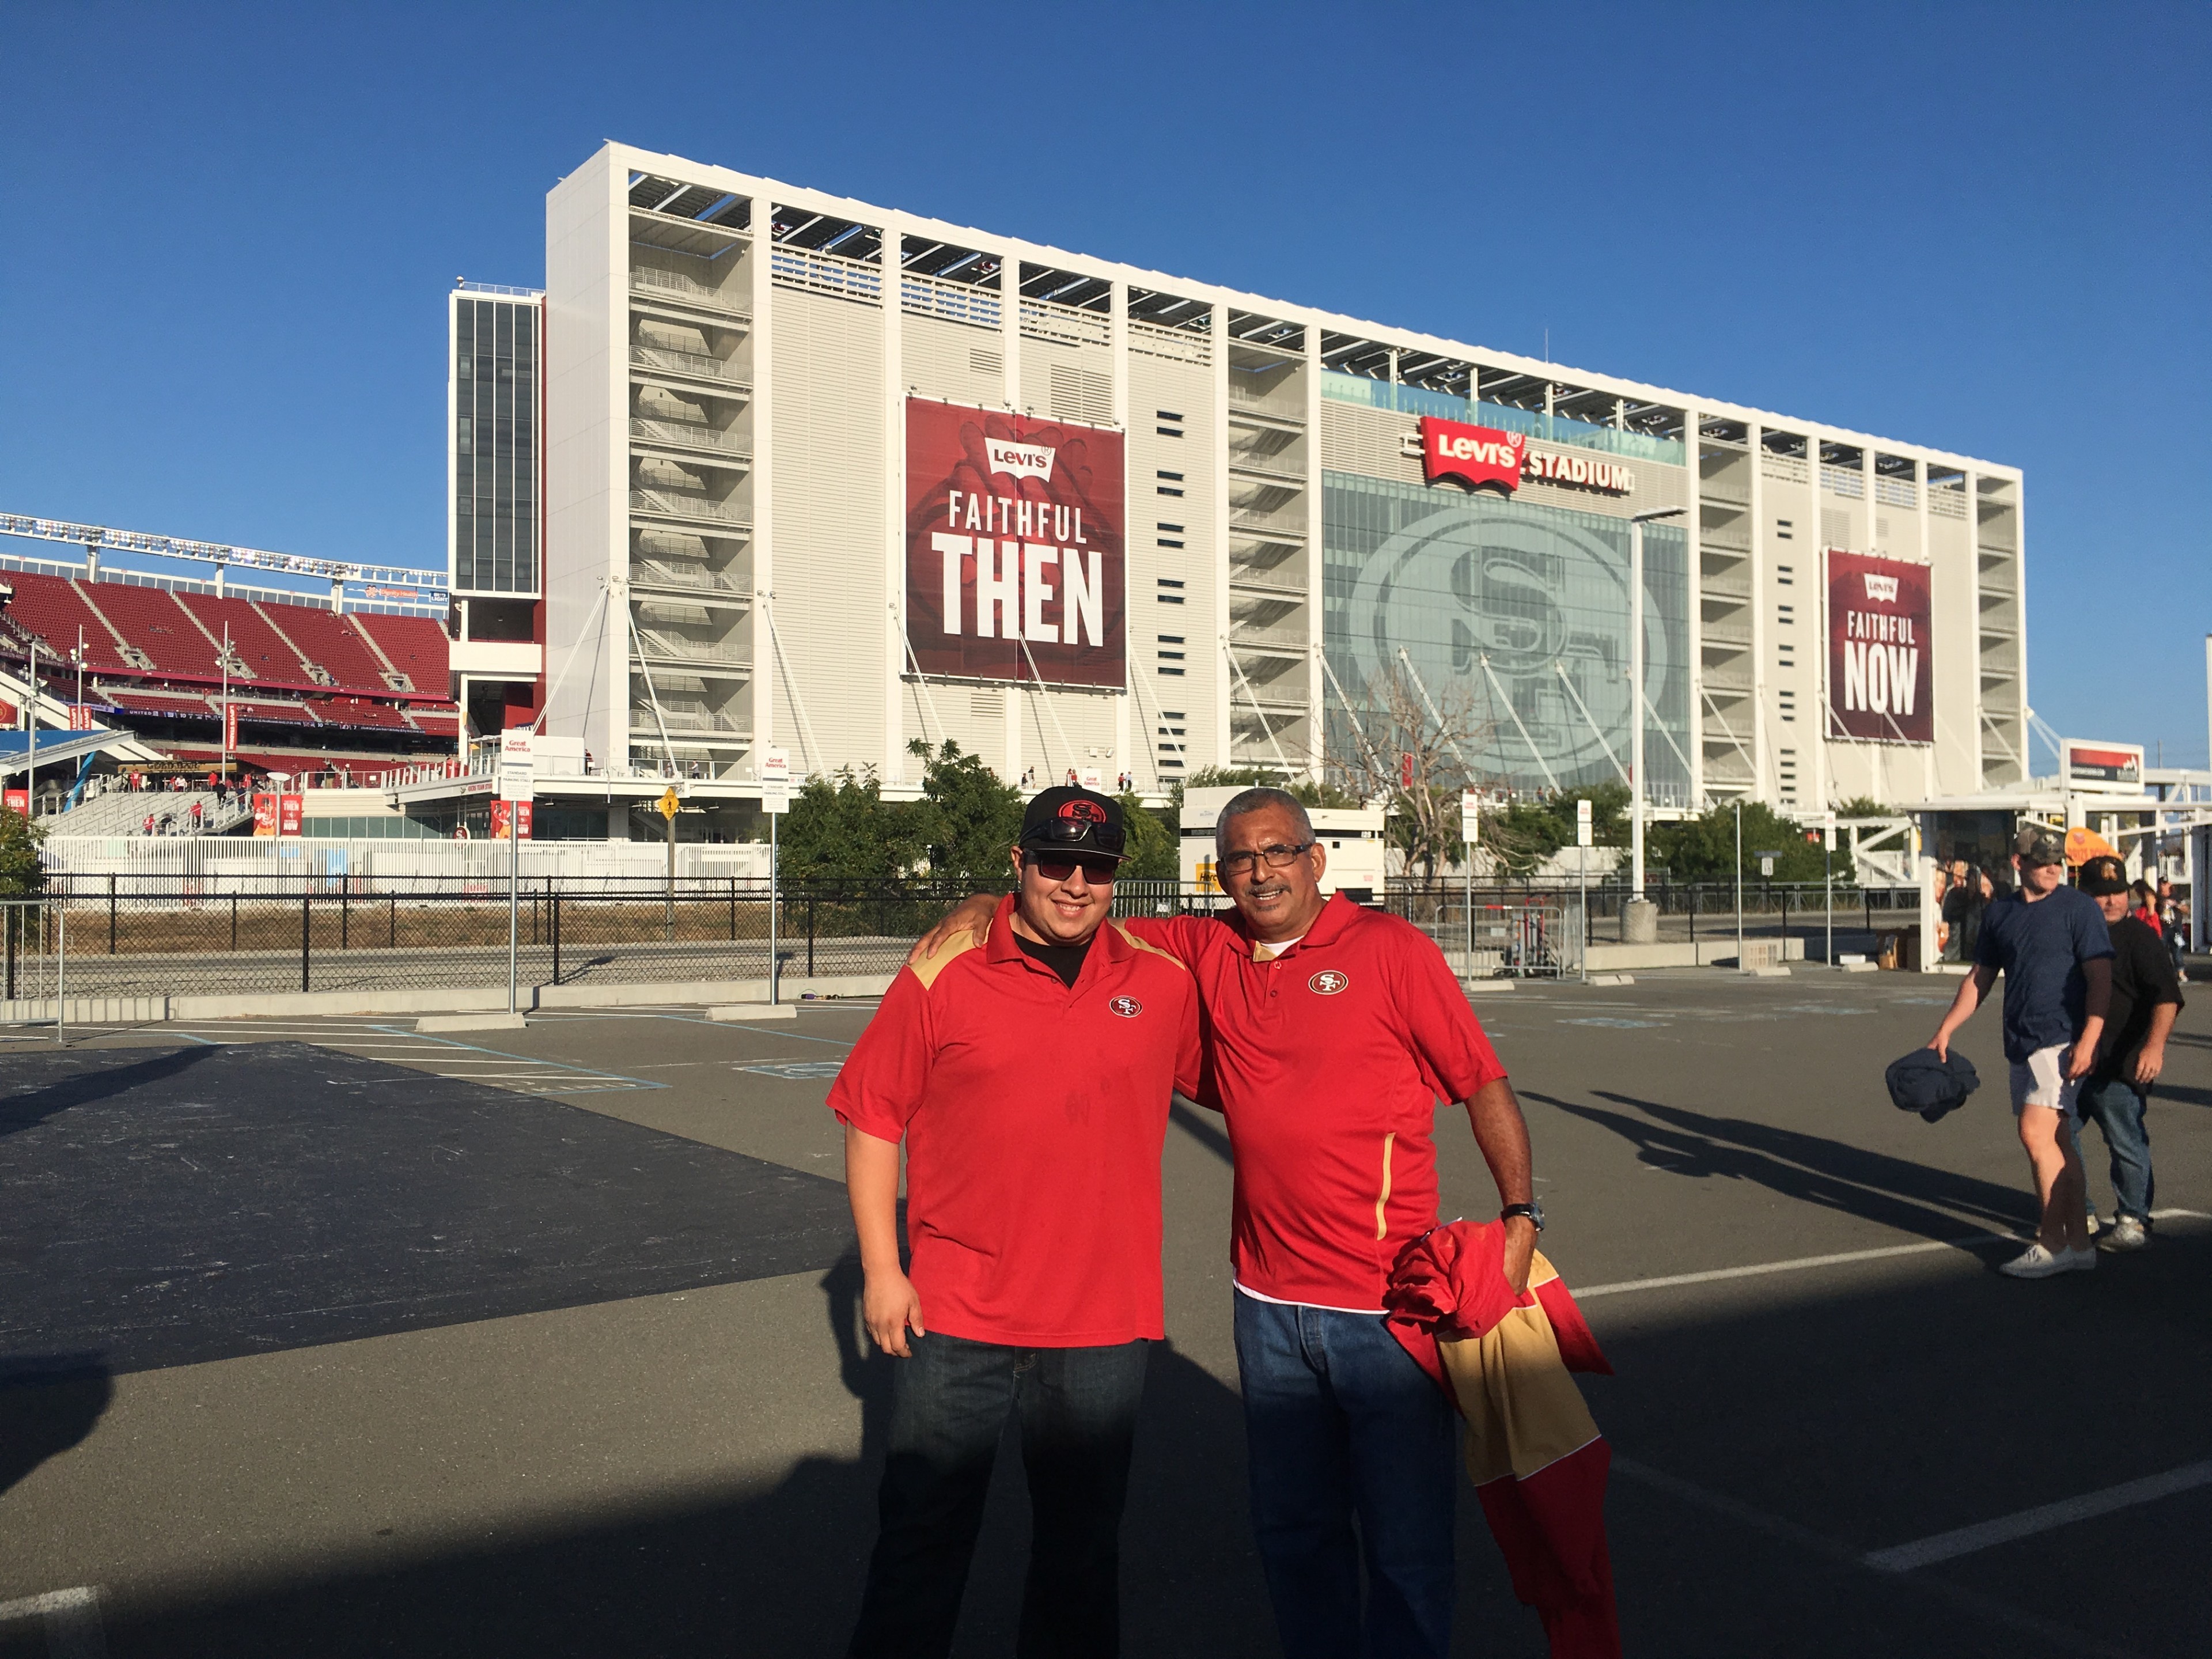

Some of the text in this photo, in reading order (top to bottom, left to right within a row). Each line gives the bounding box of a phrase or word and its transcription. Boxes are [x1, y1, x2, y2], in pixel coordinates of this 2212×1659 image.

[1528, 450, 1631, 491] STADIUM
[949, 490, 1087, 544] FAITHFUL
[381, 588, 399, 598] Dignity
[931, 531, 1104, 647] THEN
[1847, 609, 1916, 645] FAITHFUL
[1844, 639, 1919, 715] NOW
[6, 798, 25, 808] THEN
[283, 802, 300, 812] THEN
[283, 823, 298, 831] NOW
